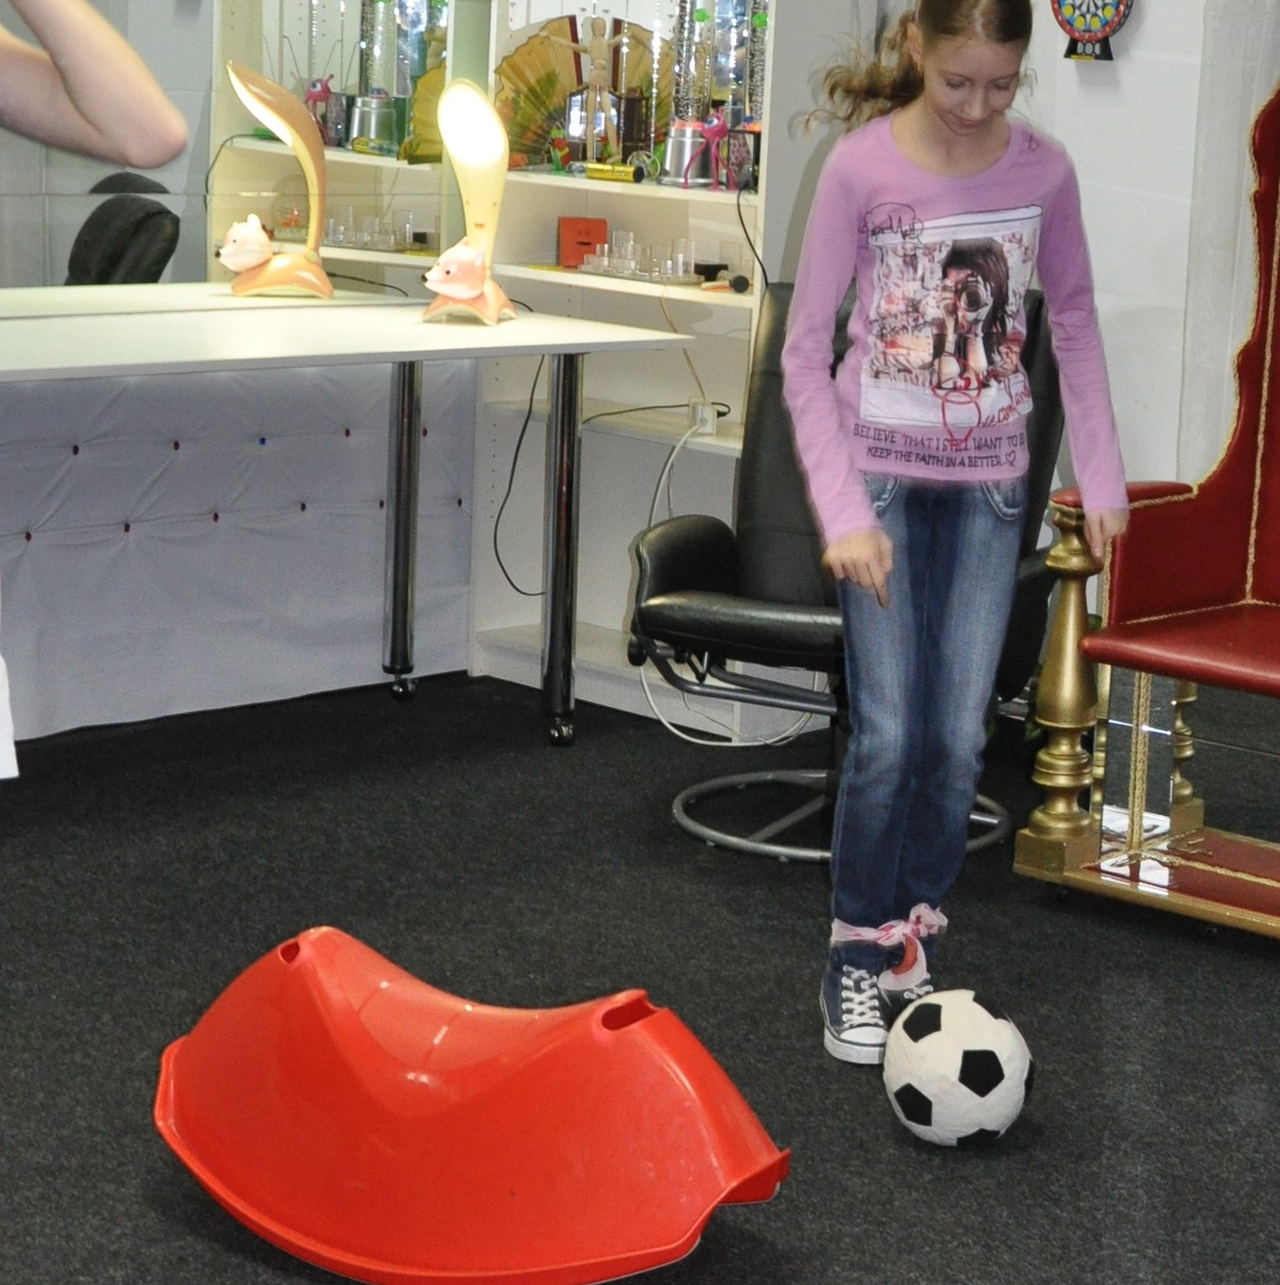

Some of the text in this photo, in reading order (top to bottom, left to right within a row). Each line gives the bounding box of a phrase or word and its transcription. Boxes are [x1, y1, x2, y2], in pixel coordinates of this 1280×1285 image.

[852, 423, 898, 444] BELIEVE
[902, 433, 935, 449] THAT
[942, 437, 972, 453] STILL
[972, 436, 1003, 451] WANT
[1006, 434, 1018, 448] TO
[866, 444, 892, 460] KEEP
[893, 449, 913, 463] THE
[914, 452, 944, 468] FAITH
[945, 455, 957, 468] IN
[957, 456, 967, 468] A
